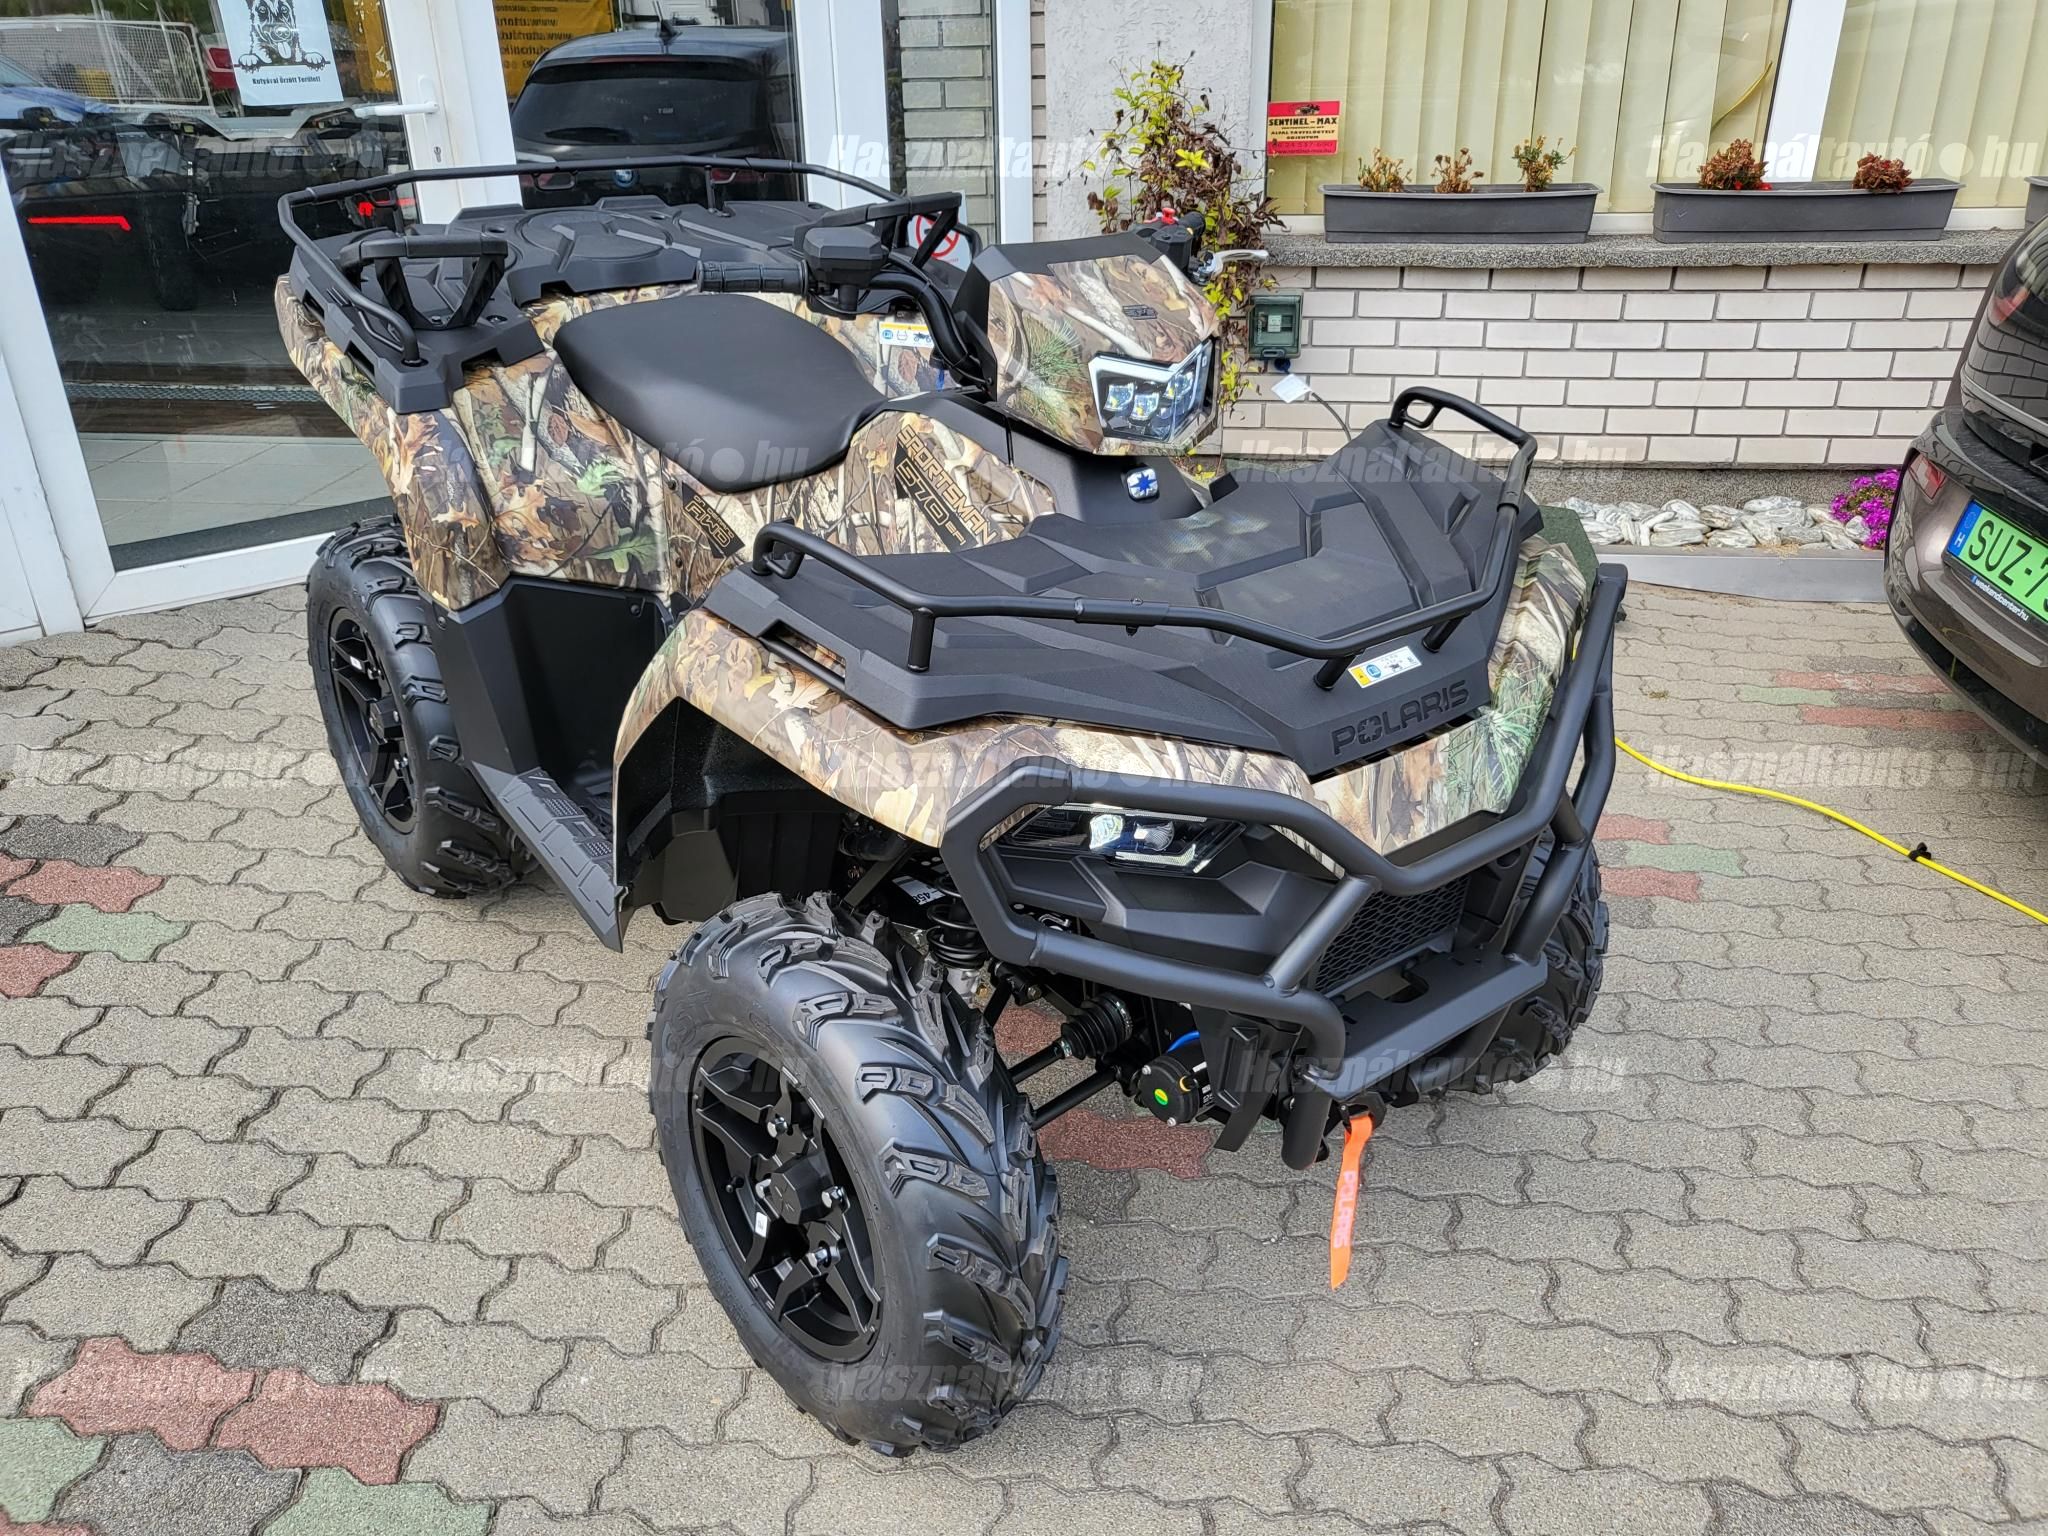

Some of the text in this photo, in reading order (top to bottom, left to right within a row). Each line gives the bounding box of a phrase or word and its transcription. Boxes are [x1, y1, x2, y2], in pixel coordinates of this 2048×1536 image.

[896, 459, 950, 525] 570
[897, 424, 998, 545] SPORTSMAN
[685, 500, 731, 547] AWD
[1954, 519, 2048, 613] H SUZ-7
[1332, 680, 1470, 756] POLARIS
[1334, 1170, 1358, 1249] POLARIS
